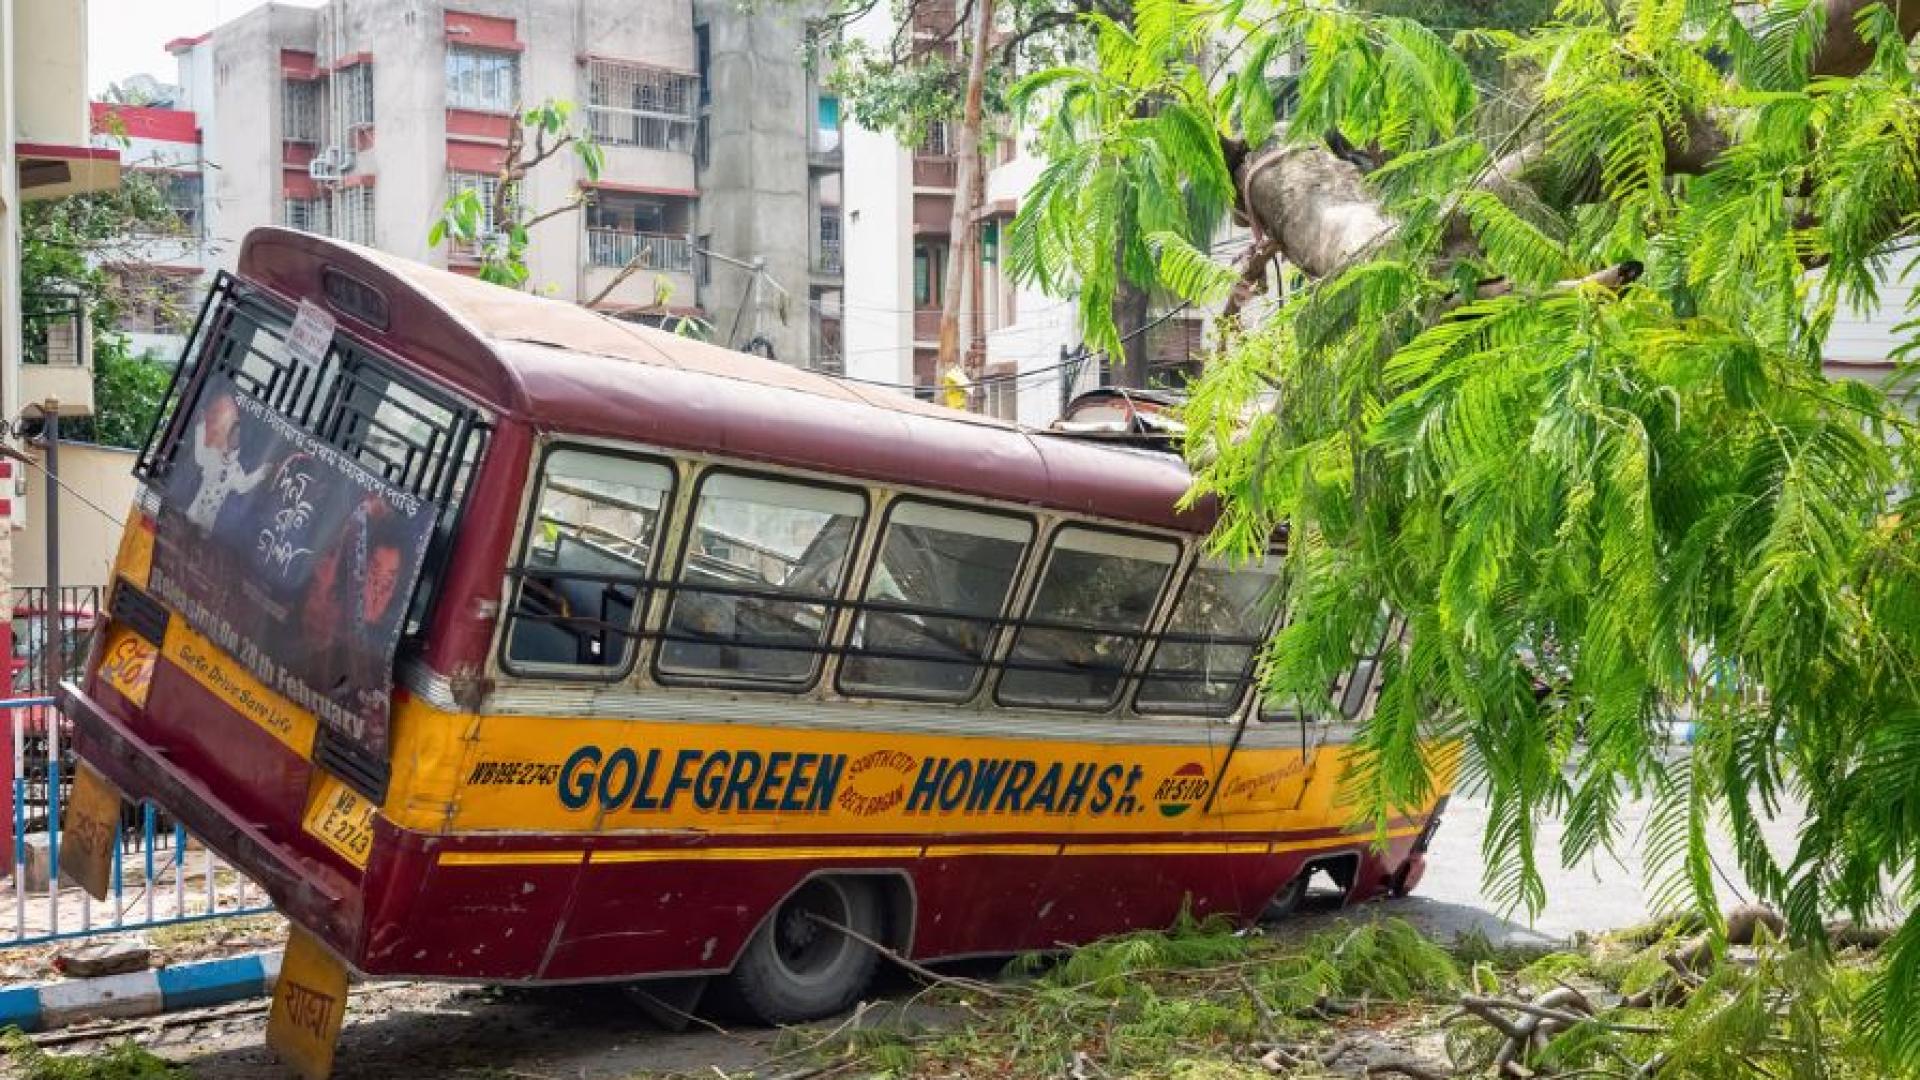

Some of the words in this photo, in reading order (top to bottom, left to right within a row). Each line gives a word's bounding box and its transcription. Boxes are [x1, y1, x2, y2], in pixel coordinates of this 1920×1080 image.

[278, 664, 365, 739] February
[904, 757, 1098, 814] HOWRAH
[322, 811, 338, 833] E
[333, 820, 370, 855] 2743
